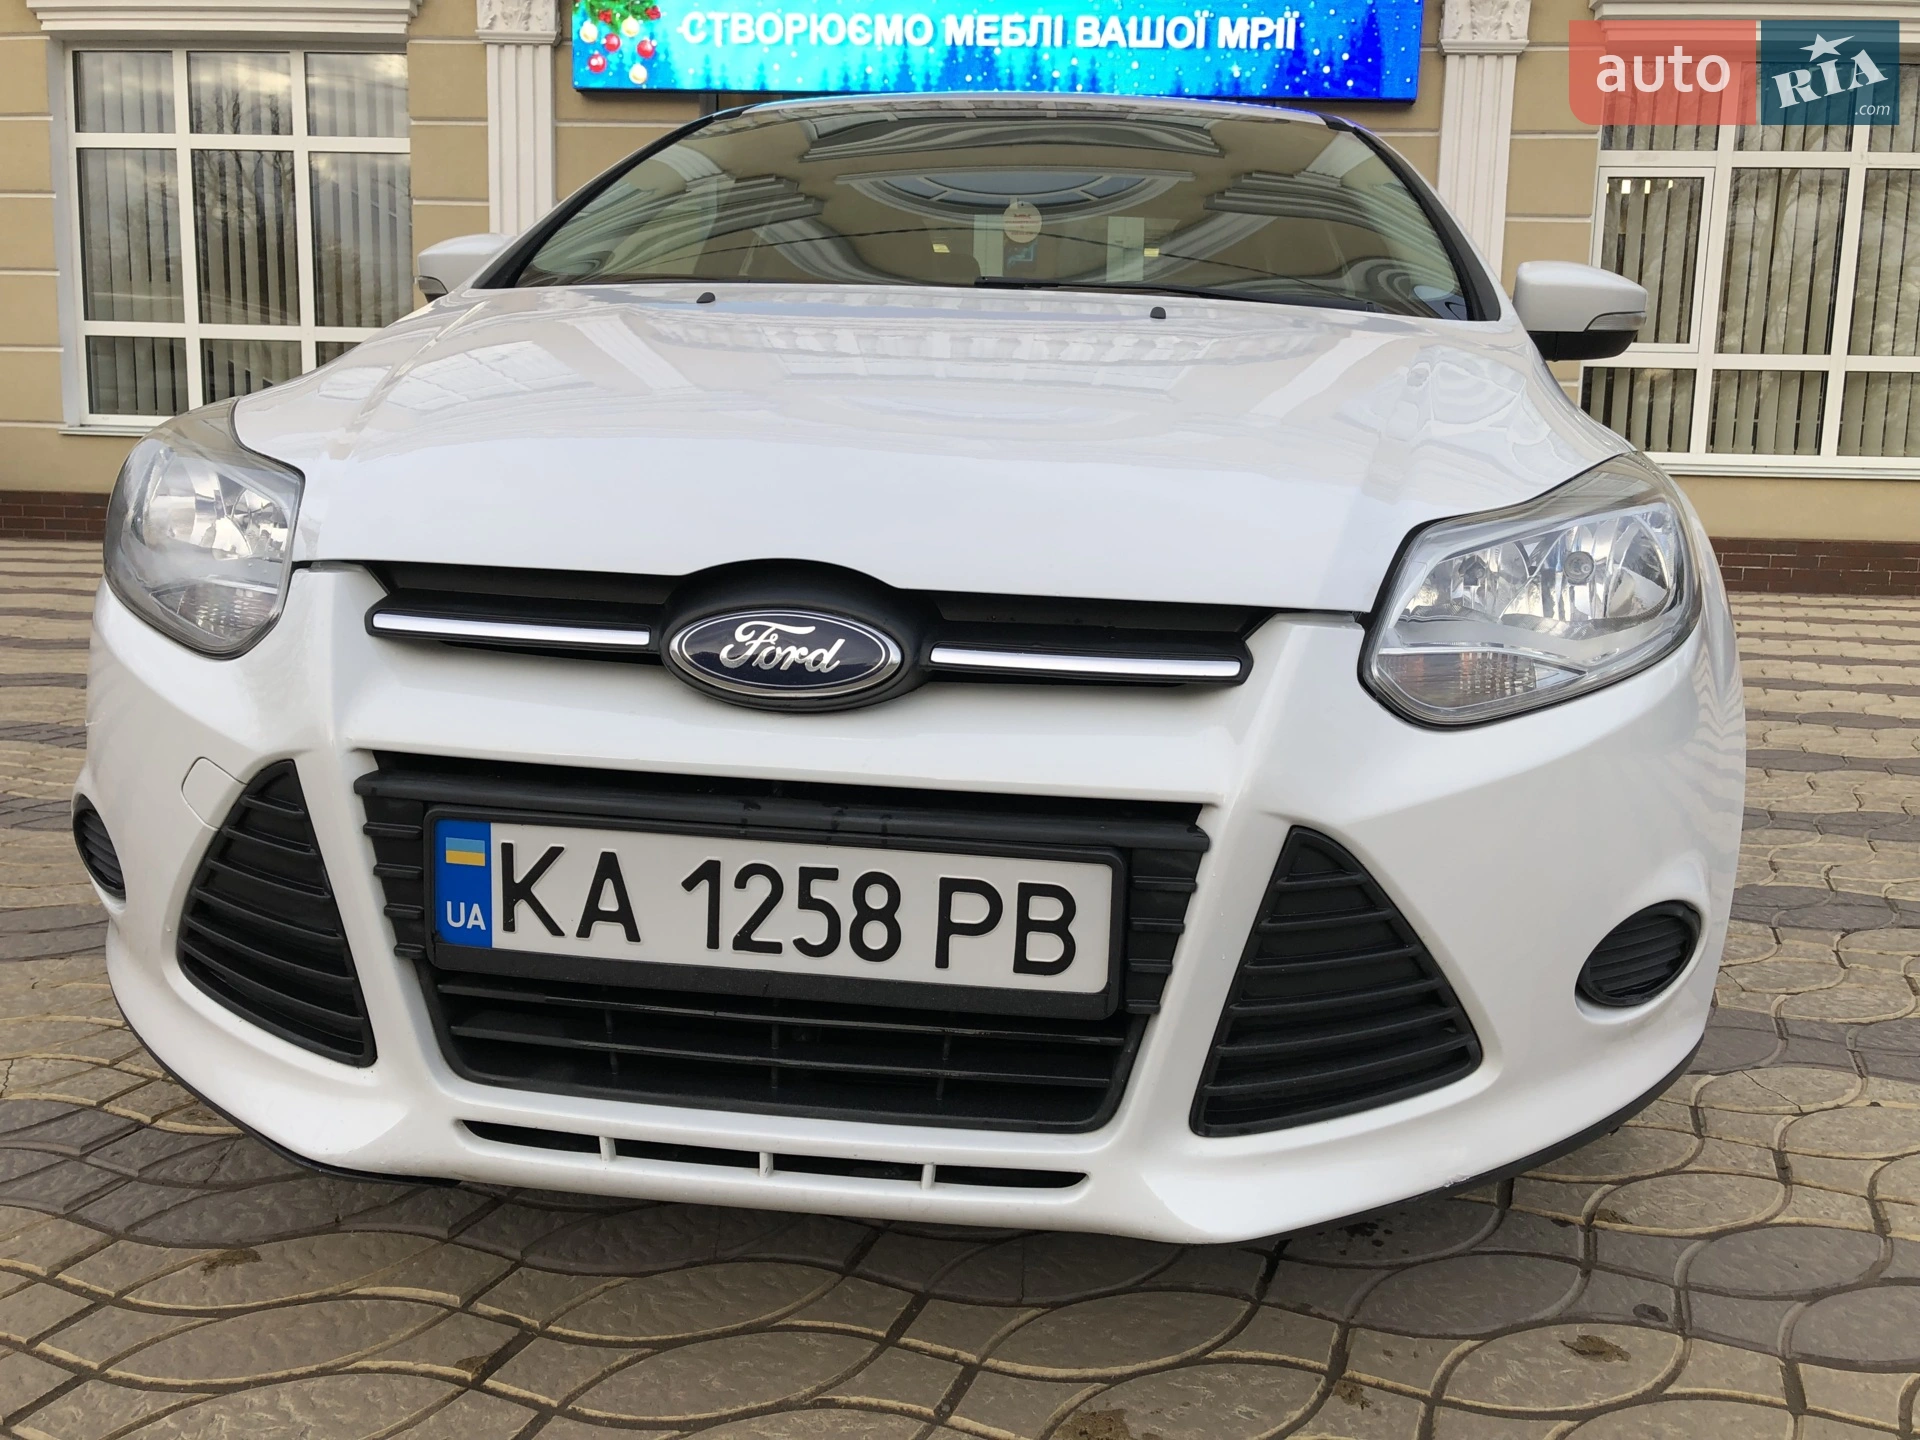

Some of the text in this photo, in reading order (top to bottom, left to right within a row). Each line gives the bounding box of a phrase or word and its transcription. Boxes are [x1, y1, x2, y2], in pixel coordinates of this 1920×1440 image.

[680, 10, 1300, 51] СТВОРЮЄМО МЕБЛІ ВАШОЇ МРІЇ
[719, 620, 846, 673] Ford
[446, 901, 486, 931] UA
[501, 841, 1077, 976] KA 1258 PB
